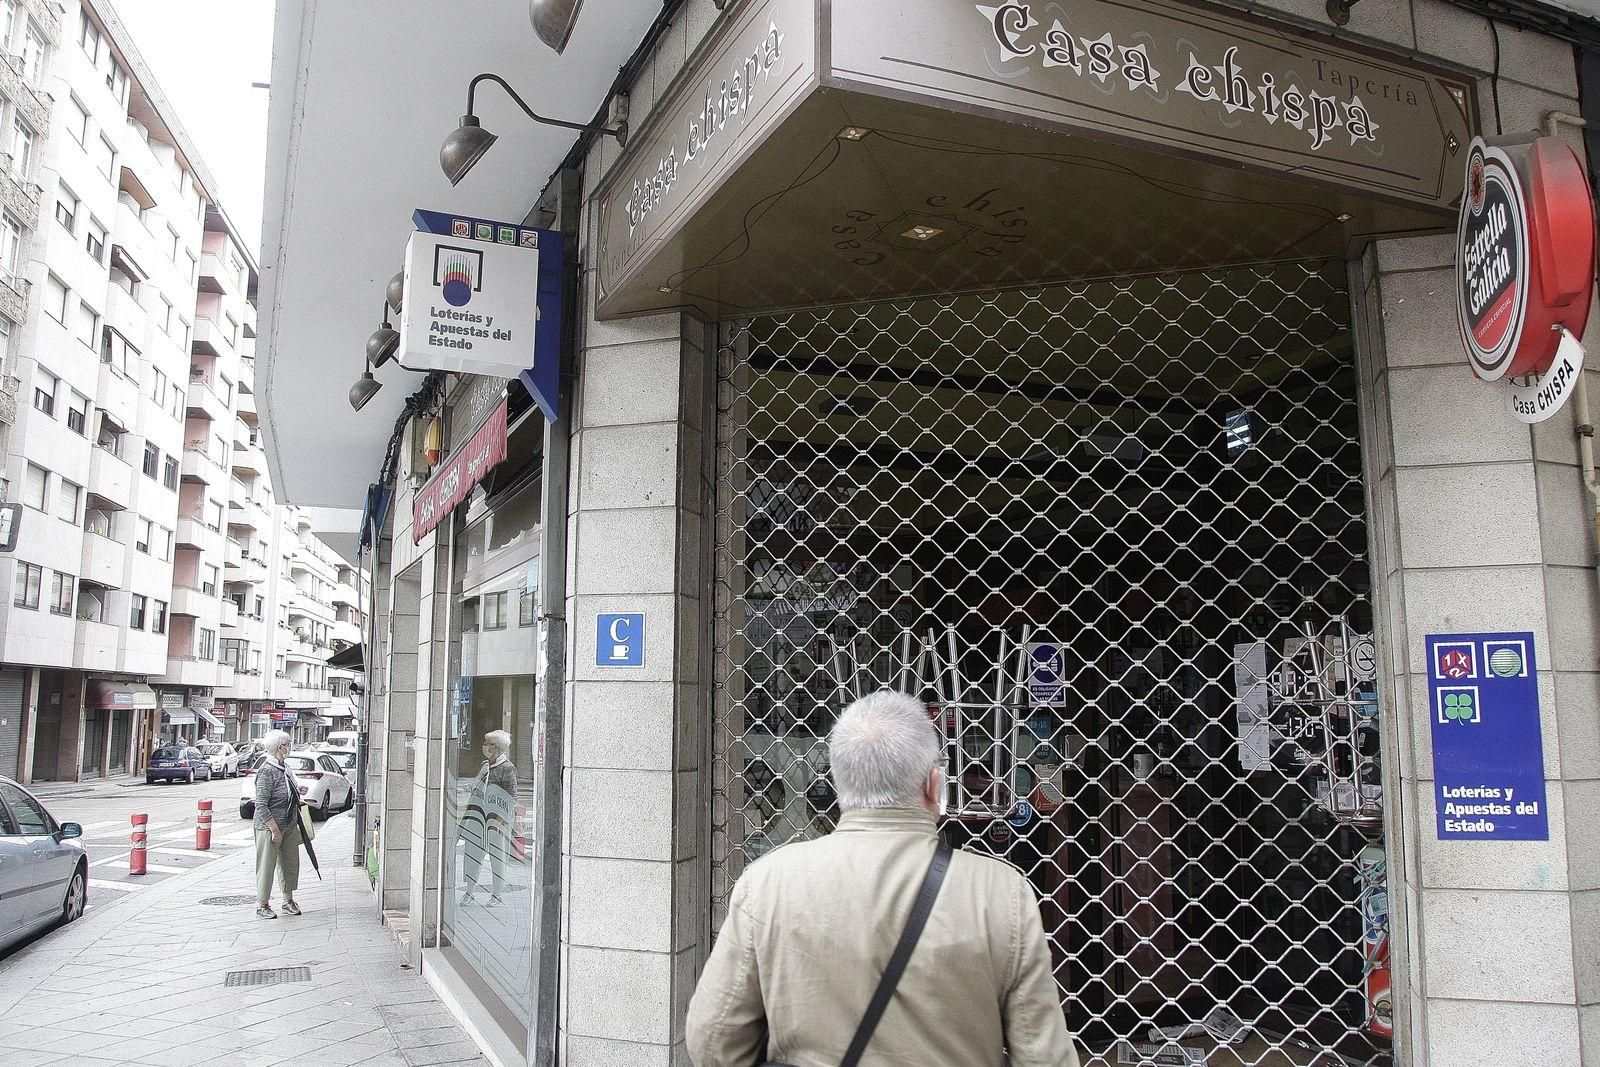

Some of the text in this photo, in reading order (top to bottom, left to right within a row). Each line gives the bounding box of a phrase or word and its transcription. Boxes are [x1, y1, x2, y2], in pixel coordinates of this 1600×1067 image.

[993, 3, 1376, 150] Casa chispa
[628, 28, 781, 230] Casa chispa
[1464, 202, 1508, 283] Estrella
[1470, 244, 1511, 316] Galicia
[430, 306, 494, 327] Loterías y
[1493, 297, 1512, 321] ESPECIAL
[428, 334, 473, 350] Estado
[429, 320, 512, 342] Apuestas del
[1512, 357, 1574, 415] Casa CHISPA
[609, 617, 630, 643] C
[1442, 784, 1514, 801] Loterías y
[1444, 801, 1539, 818] Apuestas del
[1444, 818, 1495, 833] Estado
